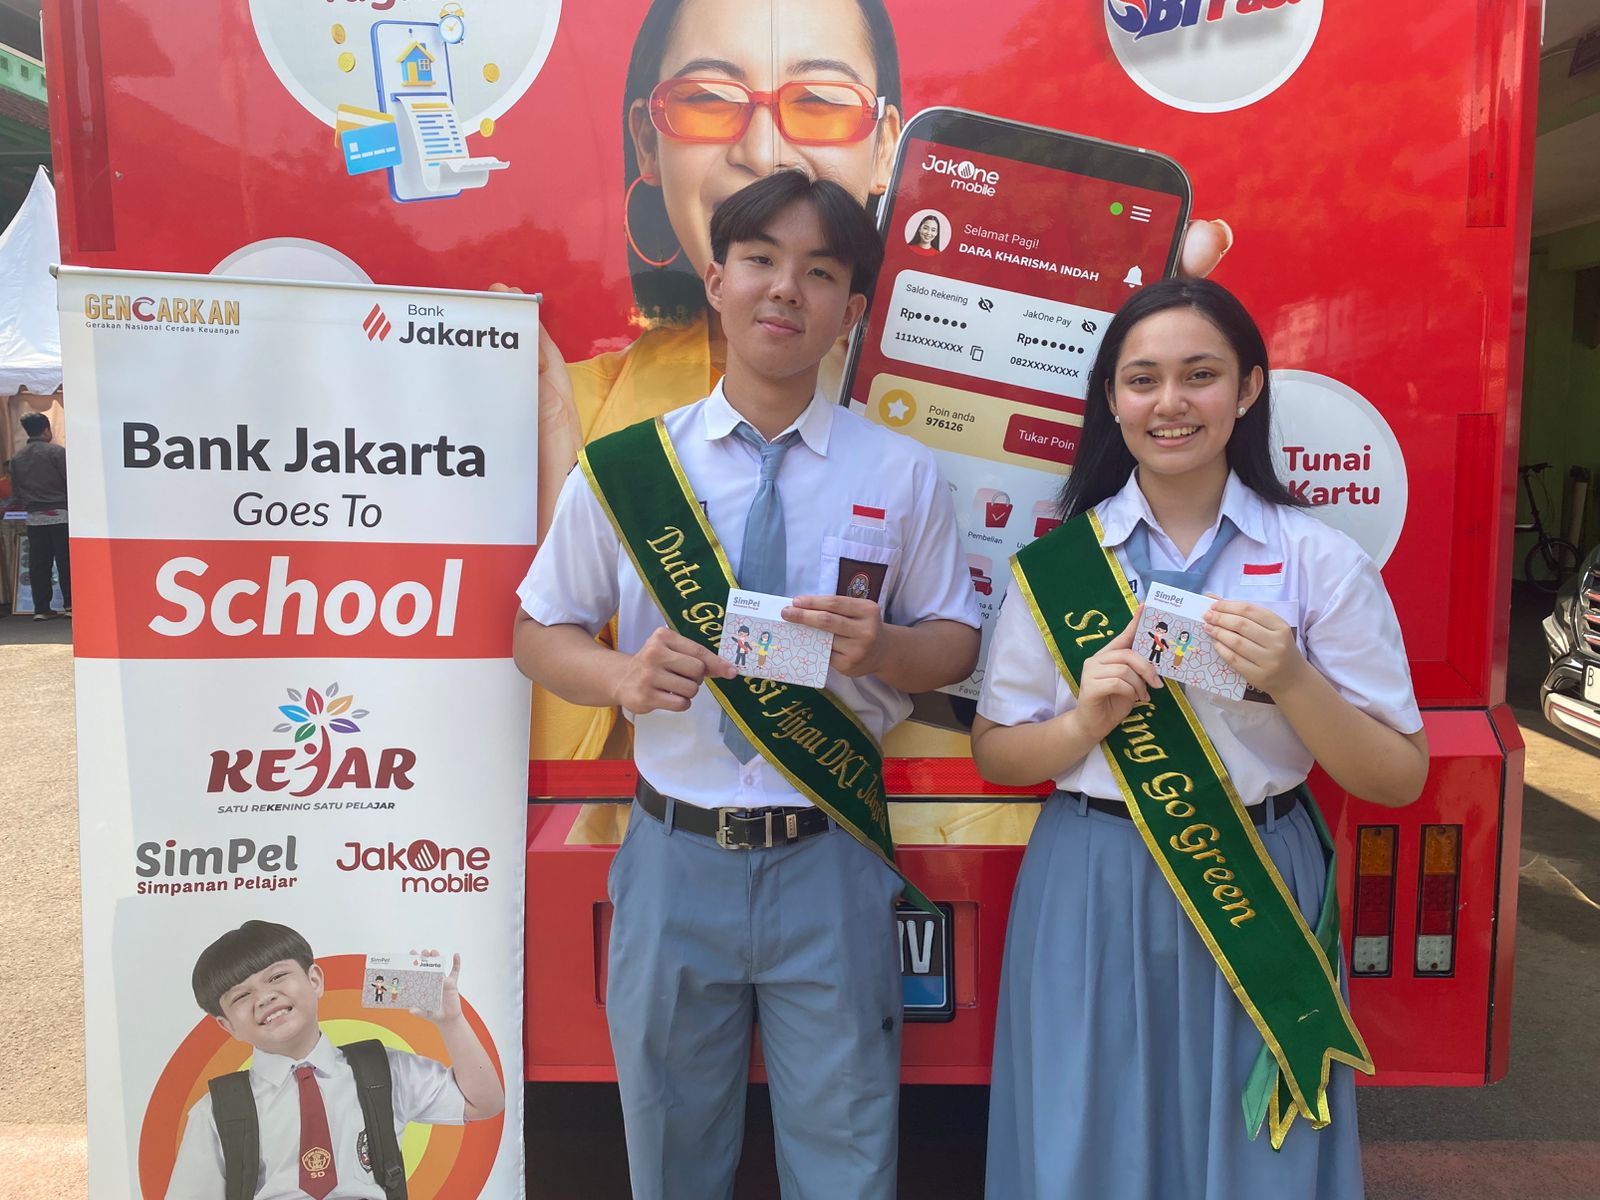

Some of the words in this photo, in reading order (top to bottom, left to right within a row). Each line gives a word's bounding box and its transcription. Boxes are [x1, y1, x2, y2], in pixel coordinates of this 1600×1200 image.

[921, 154, 1000, 184] JakOne
[950, 179, 996, 197] mobile
[963, 223, 1009, 243] Selamat
[1011, 234, 1040, 250] Pagi!
[959, 243, 992, 259] DARA
[994, 250, 1058, 273] KHARISMA
[1060, 265, 1100, 282] INDAH
[906, 283, 930, 296] Saldo
[930, 289, 969, 306] Rekening
[84, 293, 240, 325] GENCARKAN
[407, 304, 445, 318] Bank
[1023, 309, 1055, 323] JakOne
[1055, 316, 1072, 328] Pay
[125, 323, 162, 331] Nasional
[198, 326, 240, 335] Keuangan
[398, 321, 519, 350] Jakarta
[925, 417, 964, 432] 976126
[928, 405, 950, 418] Poin
[951, 410, 976, 423] anda
[122, 421, 270, 472] Bank
[284, 426, 486, 478] Jakarta
[1018, 429, 1049, 445] Tukar
[1050, 436, 1075, 450] Poin
[1282, 444, 1371, 471] Tunai
[1288, 480, 1380, 505] Kartu
[232, 491, 330, 528] Goes
[341, 494, 382, 528] To
[967, 531, 1003, 544] Pembelian
[147, 555, 464, 637] School
[733, 596, 760, 607] SimPel
[1154, 590, 1184, 605] SimPel
[1064, 608, 1115, 649] Si
[646, 525, 701, 600] Duta
[816, 738, 870, 789] DKI
[1587, 667, 1594, 686] B
[1141, 771, 1197, 818] Go
[217, 805, 248, 814] SATU
[251, 803, 311, 812] REKENING
[313, 802, 343, 811] SATU
[345, 802, 396, 810] PELAJAR
[135, 835, 298, 878] SimPel
[336, 839, 490, 872] JakOne
[136, 879, 228, 896] Simpanan
[233, 875, 298, 892] Pelajar
[401, 873, 489, 893] mobile
[1168, 823, 1256, 930] Green
[310, 1171, 326, 1179] SD
